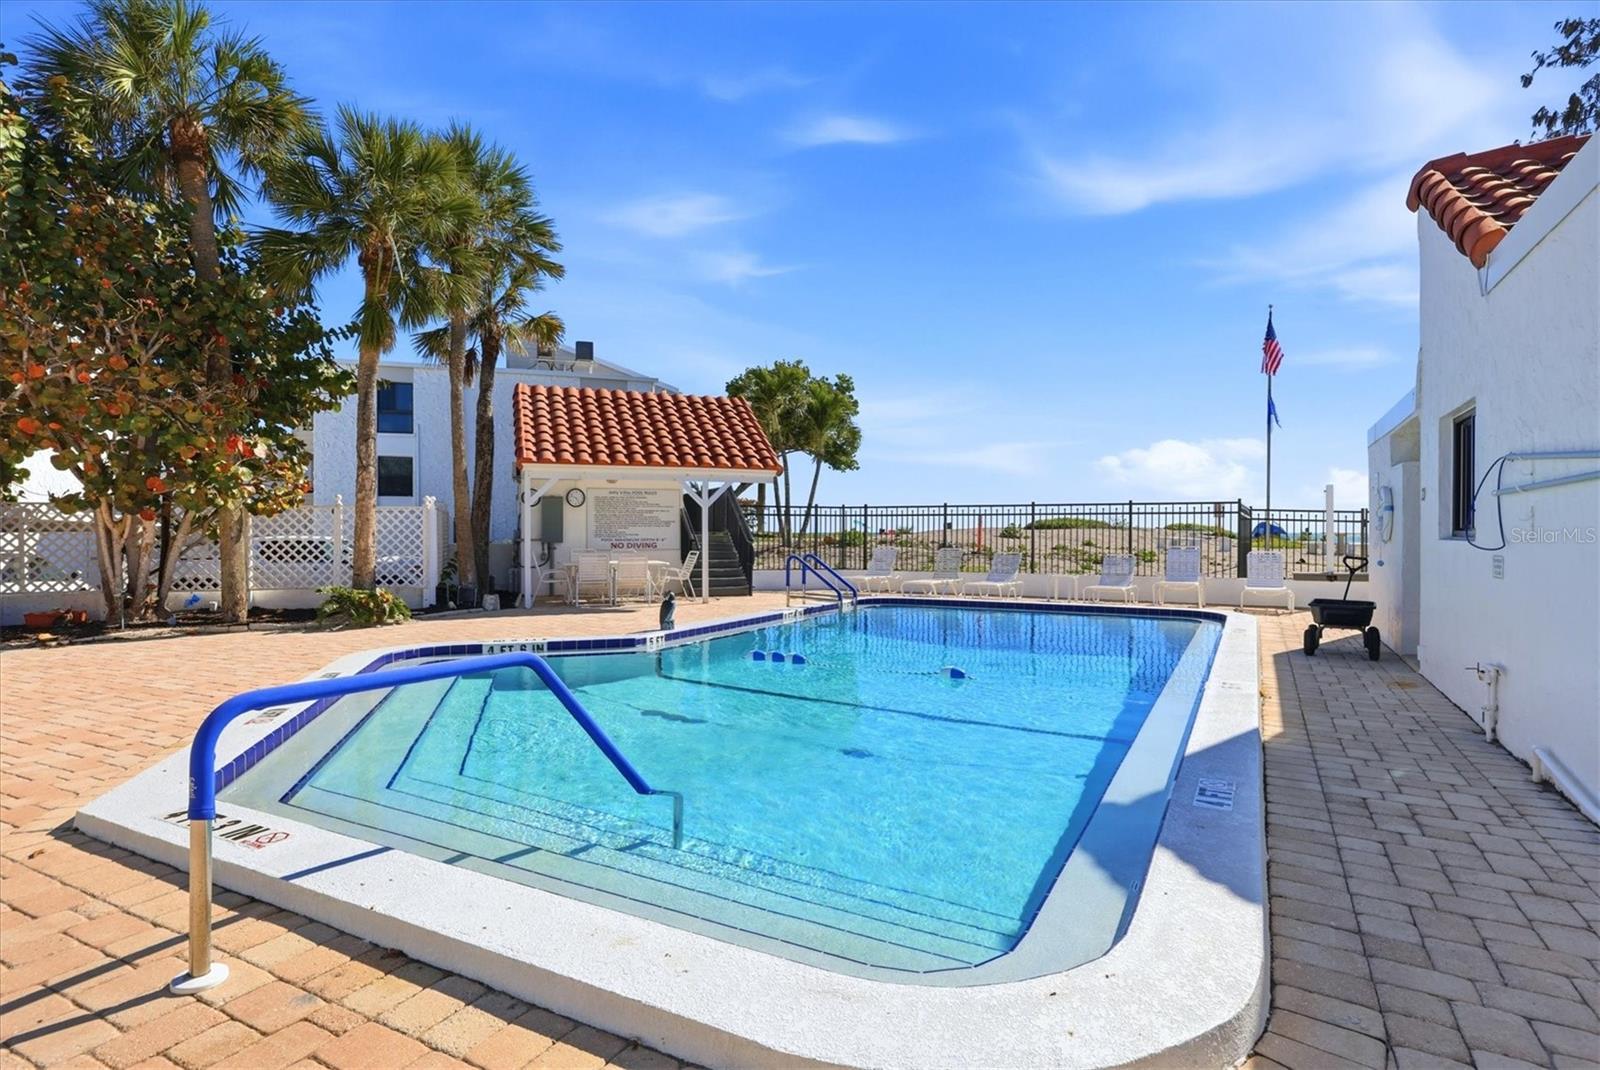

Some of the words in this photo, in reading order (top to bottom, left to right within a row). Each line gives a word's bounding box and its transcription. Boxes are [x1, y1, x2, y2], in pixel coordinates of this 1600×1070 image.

[487, 646, 494, 655] 4
[500, 645, 514, 653] FT
[532, 644, 544, 653] IN
[219, 824, 271, 841] IN
